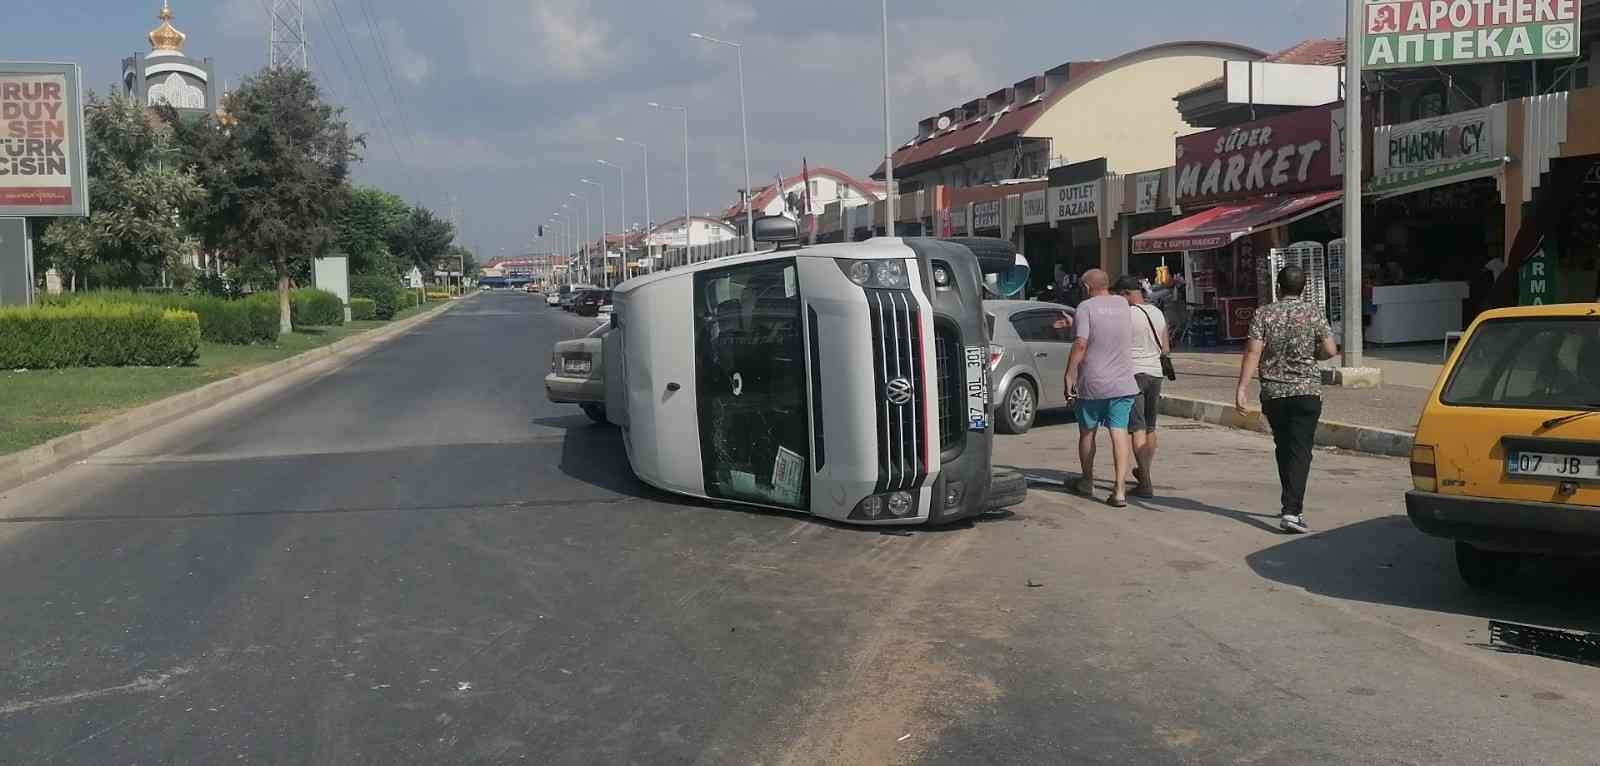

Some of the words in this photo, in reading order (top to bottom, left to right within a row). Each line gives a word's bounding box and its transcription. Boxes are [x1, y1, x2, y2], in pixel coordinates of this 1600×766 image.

[1407, 0, 1574, 30] APOTHEKE
[1369, 29, 1533, 65] АПТЕКА
[3, 102, 62, 120] DUY
[8, 120, 64, 138] SEN
[0, 138, 64, 156] ÜRK
[1215, 127, 1273, 154] SÜPER
[1389, 122, 1485, 165] PHARMCY
[1176, 139, 1321, 199] MARKET
[1058, 184, 1096, 202] OUTLET
[1058, 200, 1096, 217] BAZAAR
[967, 348, 980, 368] 301
[970, 407, 983, 422] 07
[1520, 454, 1543, 473] 07
[1557, 457, 1581, 475] JB
